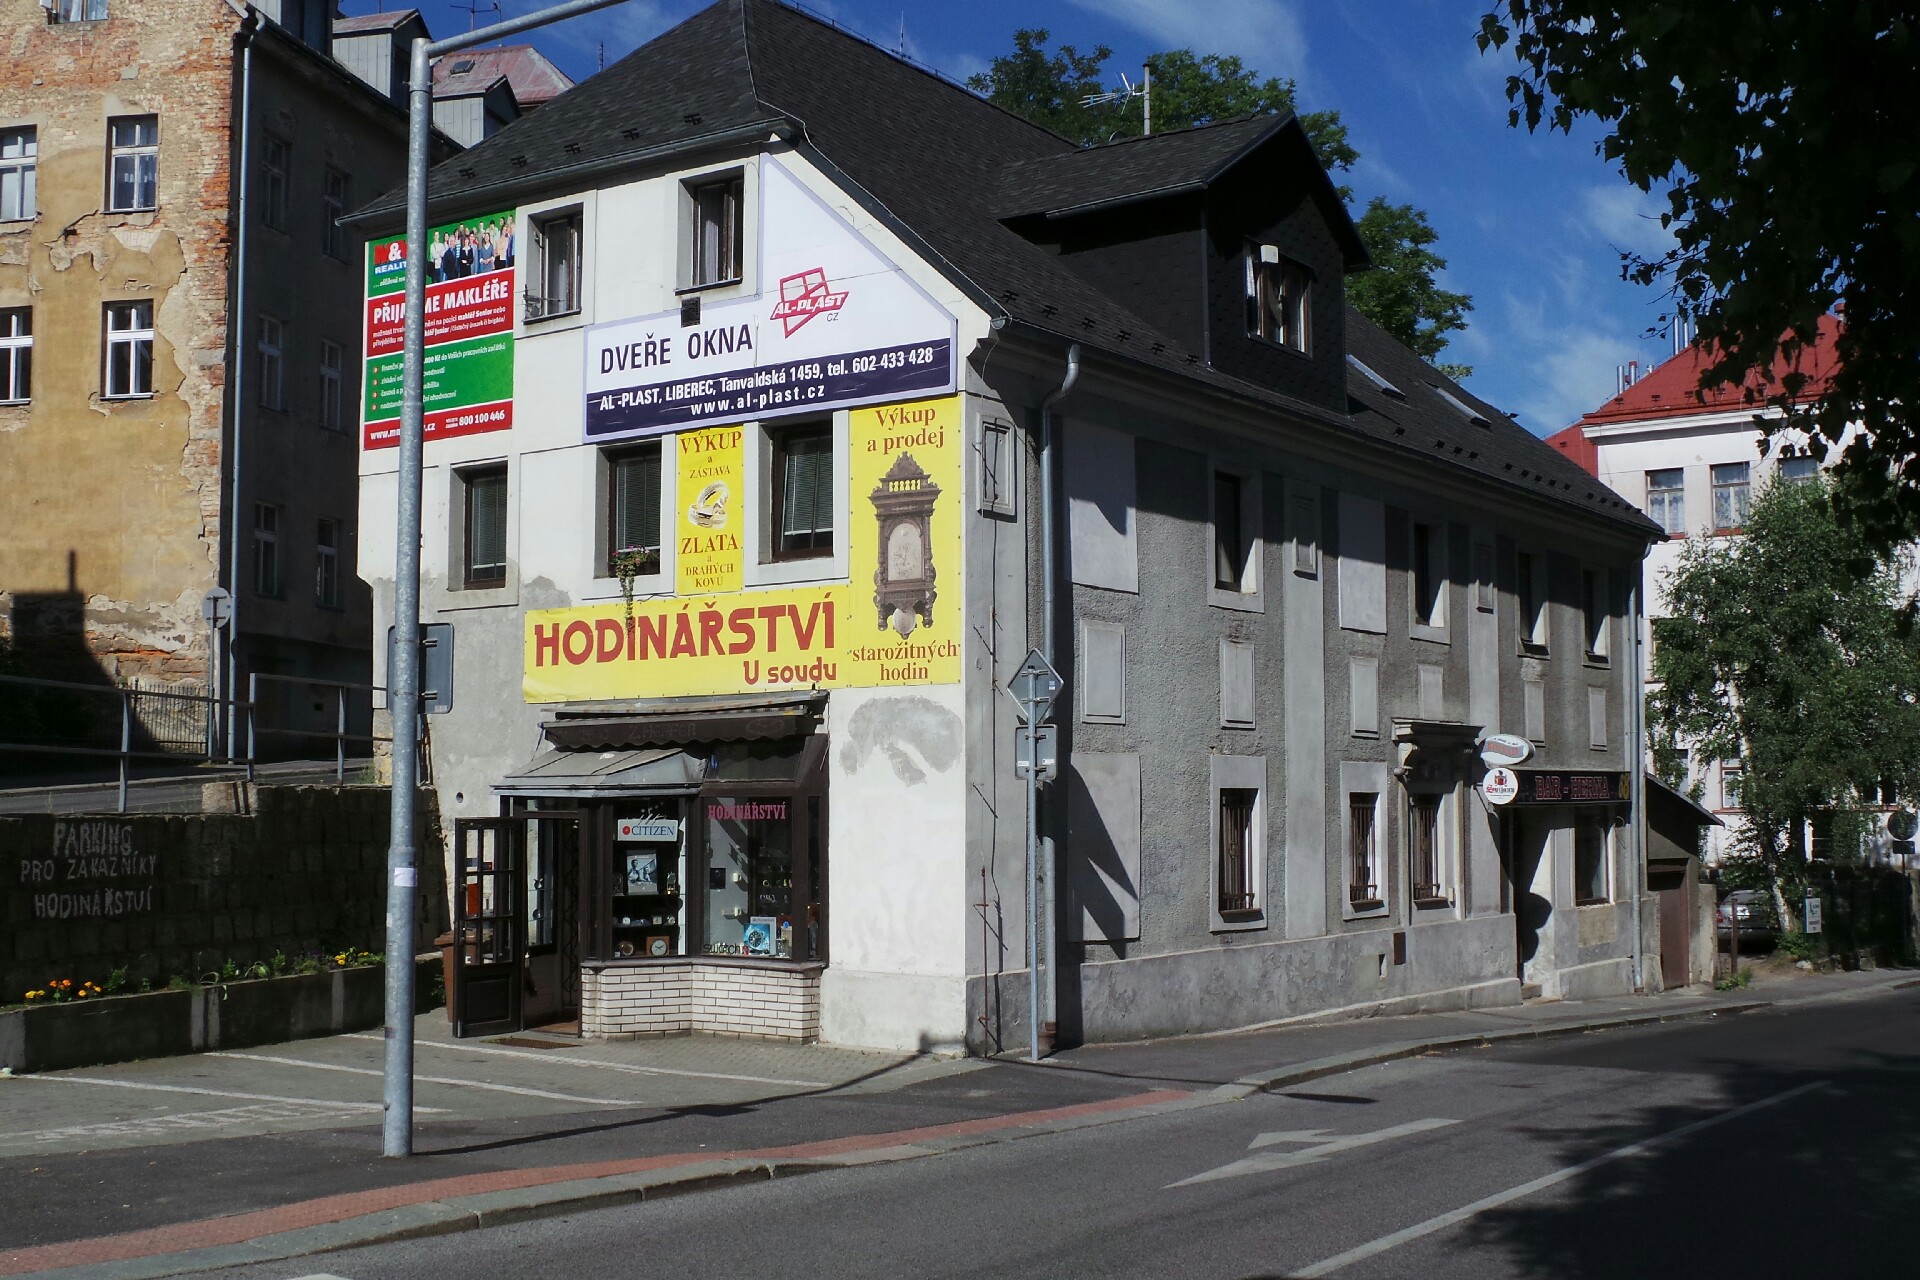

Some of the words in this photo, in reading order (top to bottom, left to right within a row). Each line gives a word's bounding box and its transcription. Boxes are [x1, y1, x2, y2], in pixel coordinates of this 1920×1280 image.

[375, 261, 407, 275] REALIT
[443, 280, 509, 310] MAKLÉŘE
[771, 292, 847, 318] AL-PLAST
[600, 332, 672, 375] DVEŘE
[687, 323, 753, 360] OKNA
[665, 380, 718, 403] LIBEREC,
[719, 369, 787, 394] Tanvaldská
[789, 364, 825, 383] 1459,
[827, 360, 849, 378] tel.
[852, 355, 878, 374] 602
[879, 351, 906, 371] 433
[908, 347, 934, 366] 428
[690, 384, 825, 416] www.al-plast.cz
[458, 413, 474, 427] 800
[474, 411, 489, 425] 100
[489, 409, 506, 424] 446
[875, 407, 937, 430] Výkup
[680, 429, 742, 454] VÝKUP
[867, 438, 878, 452] a
[883, 425, 945, 455] prodej
[689, 465, 731, 479] ZÁSTAVA
[681, 533, 739, 555] ZLATA
[685, 562, 734, 577] DRAHÝCH
[534, 591, 836, 668] HODINÁŘSTVÍ
[852, 640, 959, 663] starožitných
[743, 660, 760, 685] U
[767, 656, 837, 684] soudu
[879, 662, 930, 681] hodin
[1535, 775, 1562, 800] BAR
[1570, 775, 1610, 800] HERNA
[707, 801, 786, 820] HODINÁŘSTVÍ
[53, 821, 133, 858] PARKING
[631, 824, 675, 837] CITIZEN
[20, 859, 55, 882] PRO
